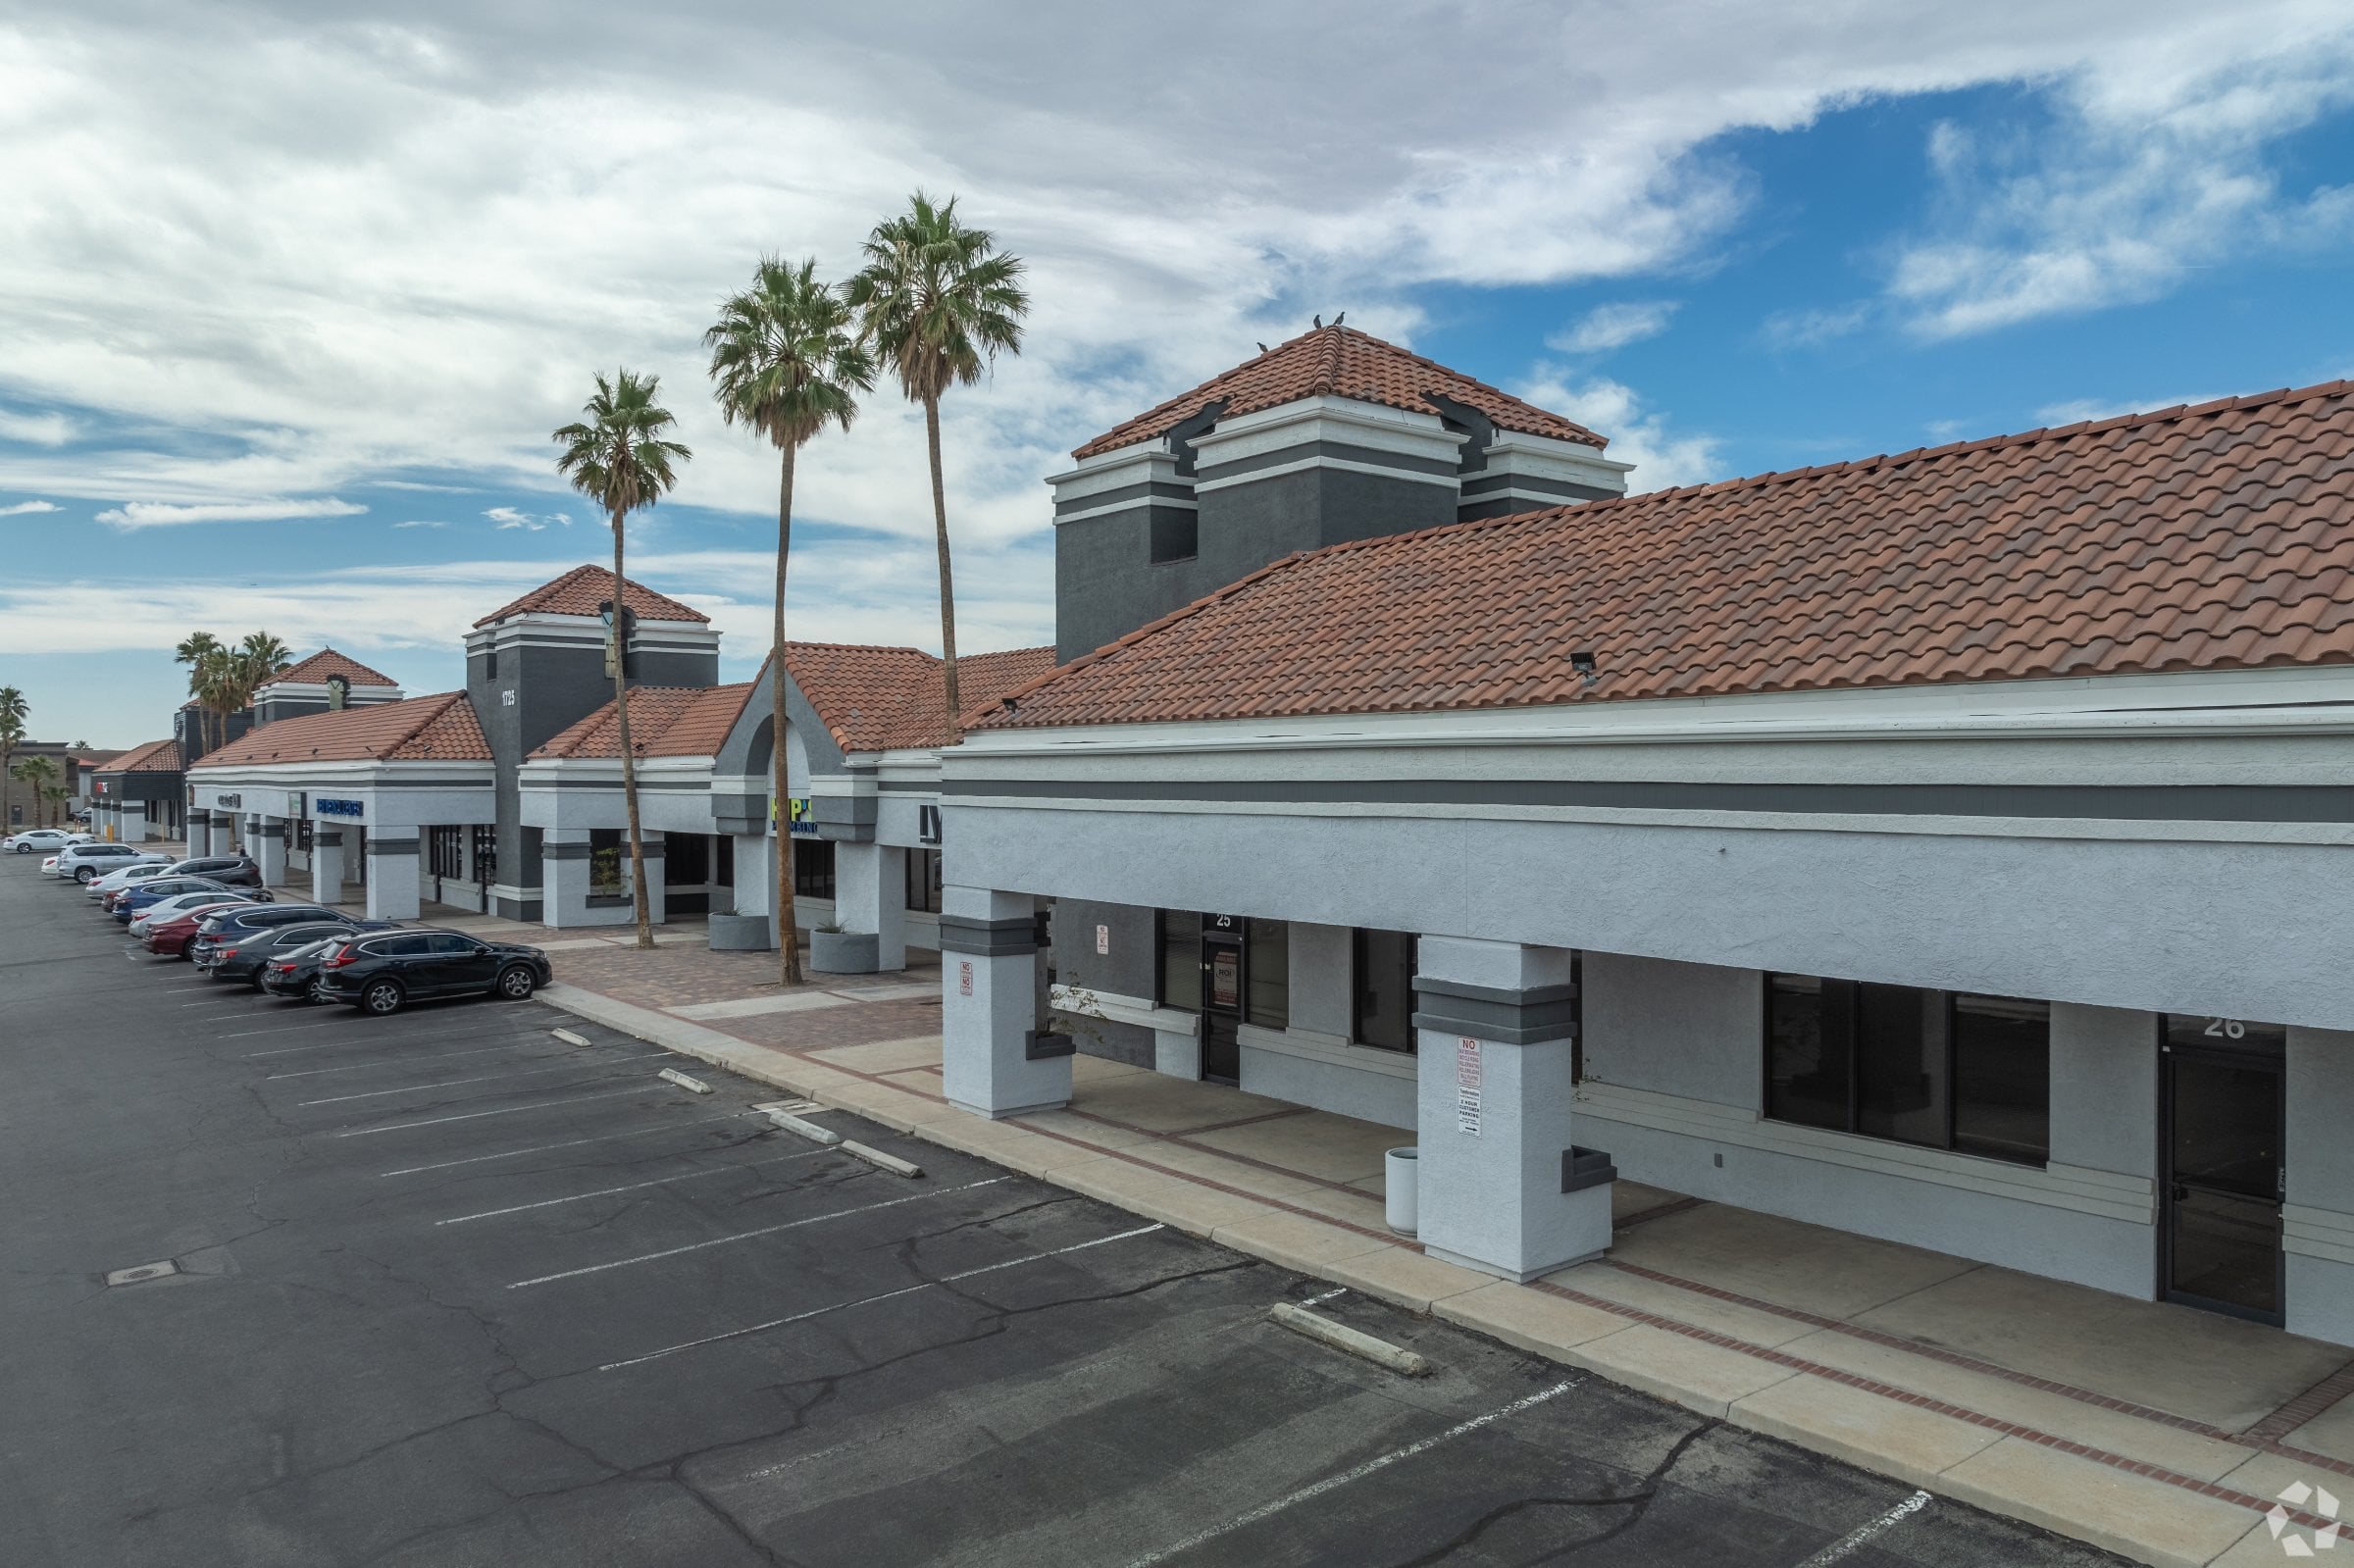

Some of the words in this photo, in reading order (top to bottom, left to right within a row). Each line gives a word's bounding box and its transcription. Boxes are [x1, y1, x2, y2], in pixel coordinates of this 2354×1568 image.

[502, 690, 515, 706] 1725
[772, 821, 817, 833] PMBIN
[1217, 914, 1230, 927] 25
[2205, 1017, 2244, 1039] 26
[1462, 1039, 1475, 1050] NO
